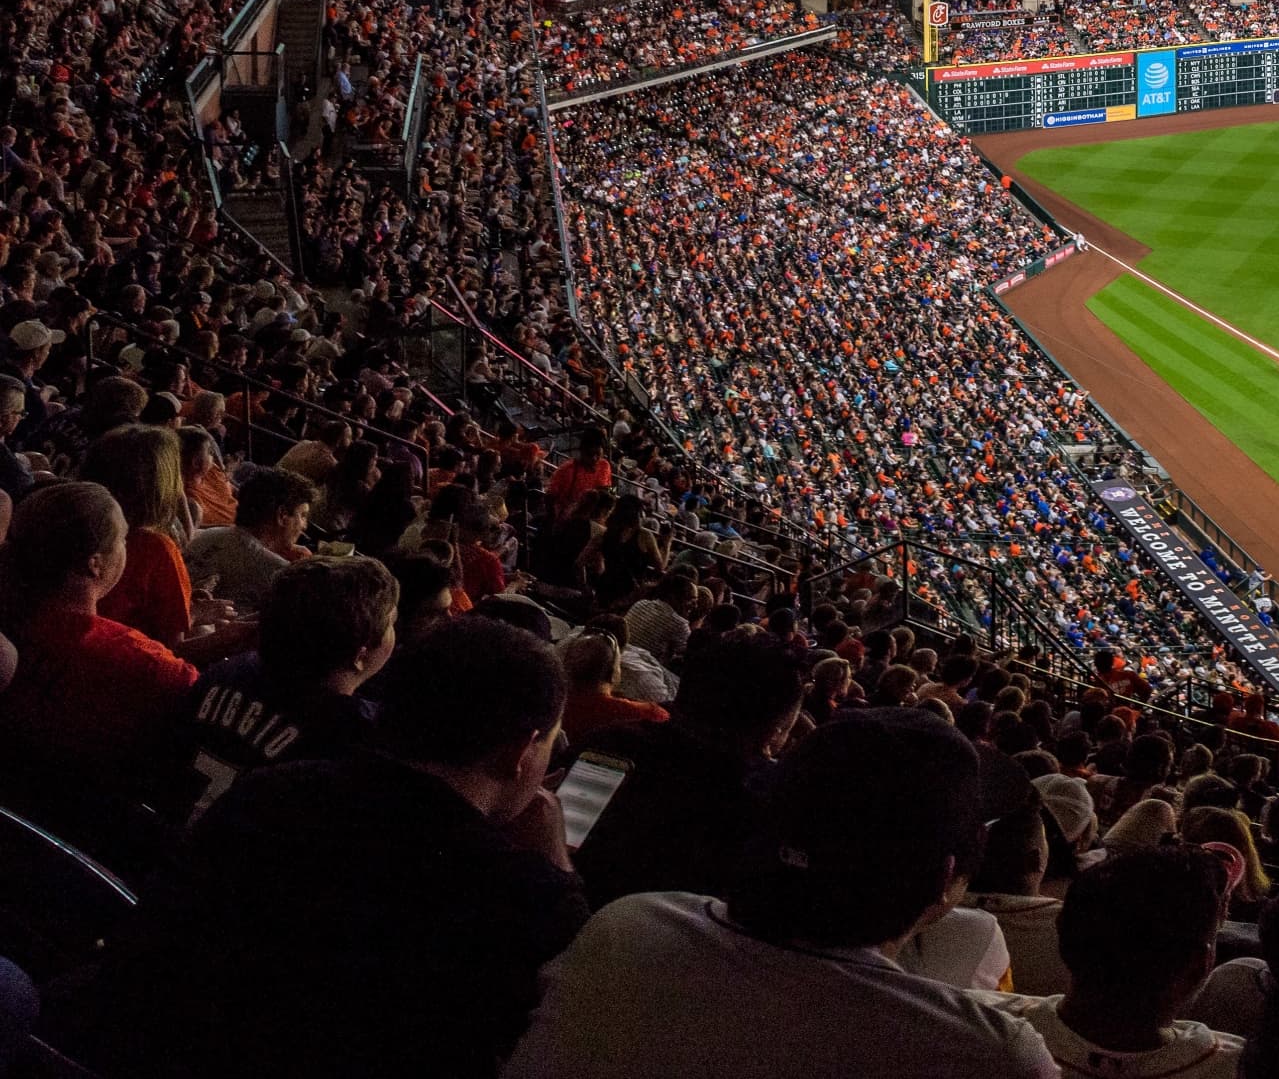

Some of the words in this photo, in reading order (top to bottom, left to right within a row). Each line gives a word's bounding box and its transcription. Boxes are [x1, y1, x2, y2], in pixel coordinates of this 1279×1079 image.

[1142, 91, 1171, 105] AT&T
[1136, 505, 1170, 537] HOME
[1120, 506, 1187, 571] WELCOME
[1177, 571, 1205, 592] TO
[1199, 594, 1266, 654] MINUTE
[198, 685, 301, 757] BIGGIO
[190, 751, 239, 816] 7
